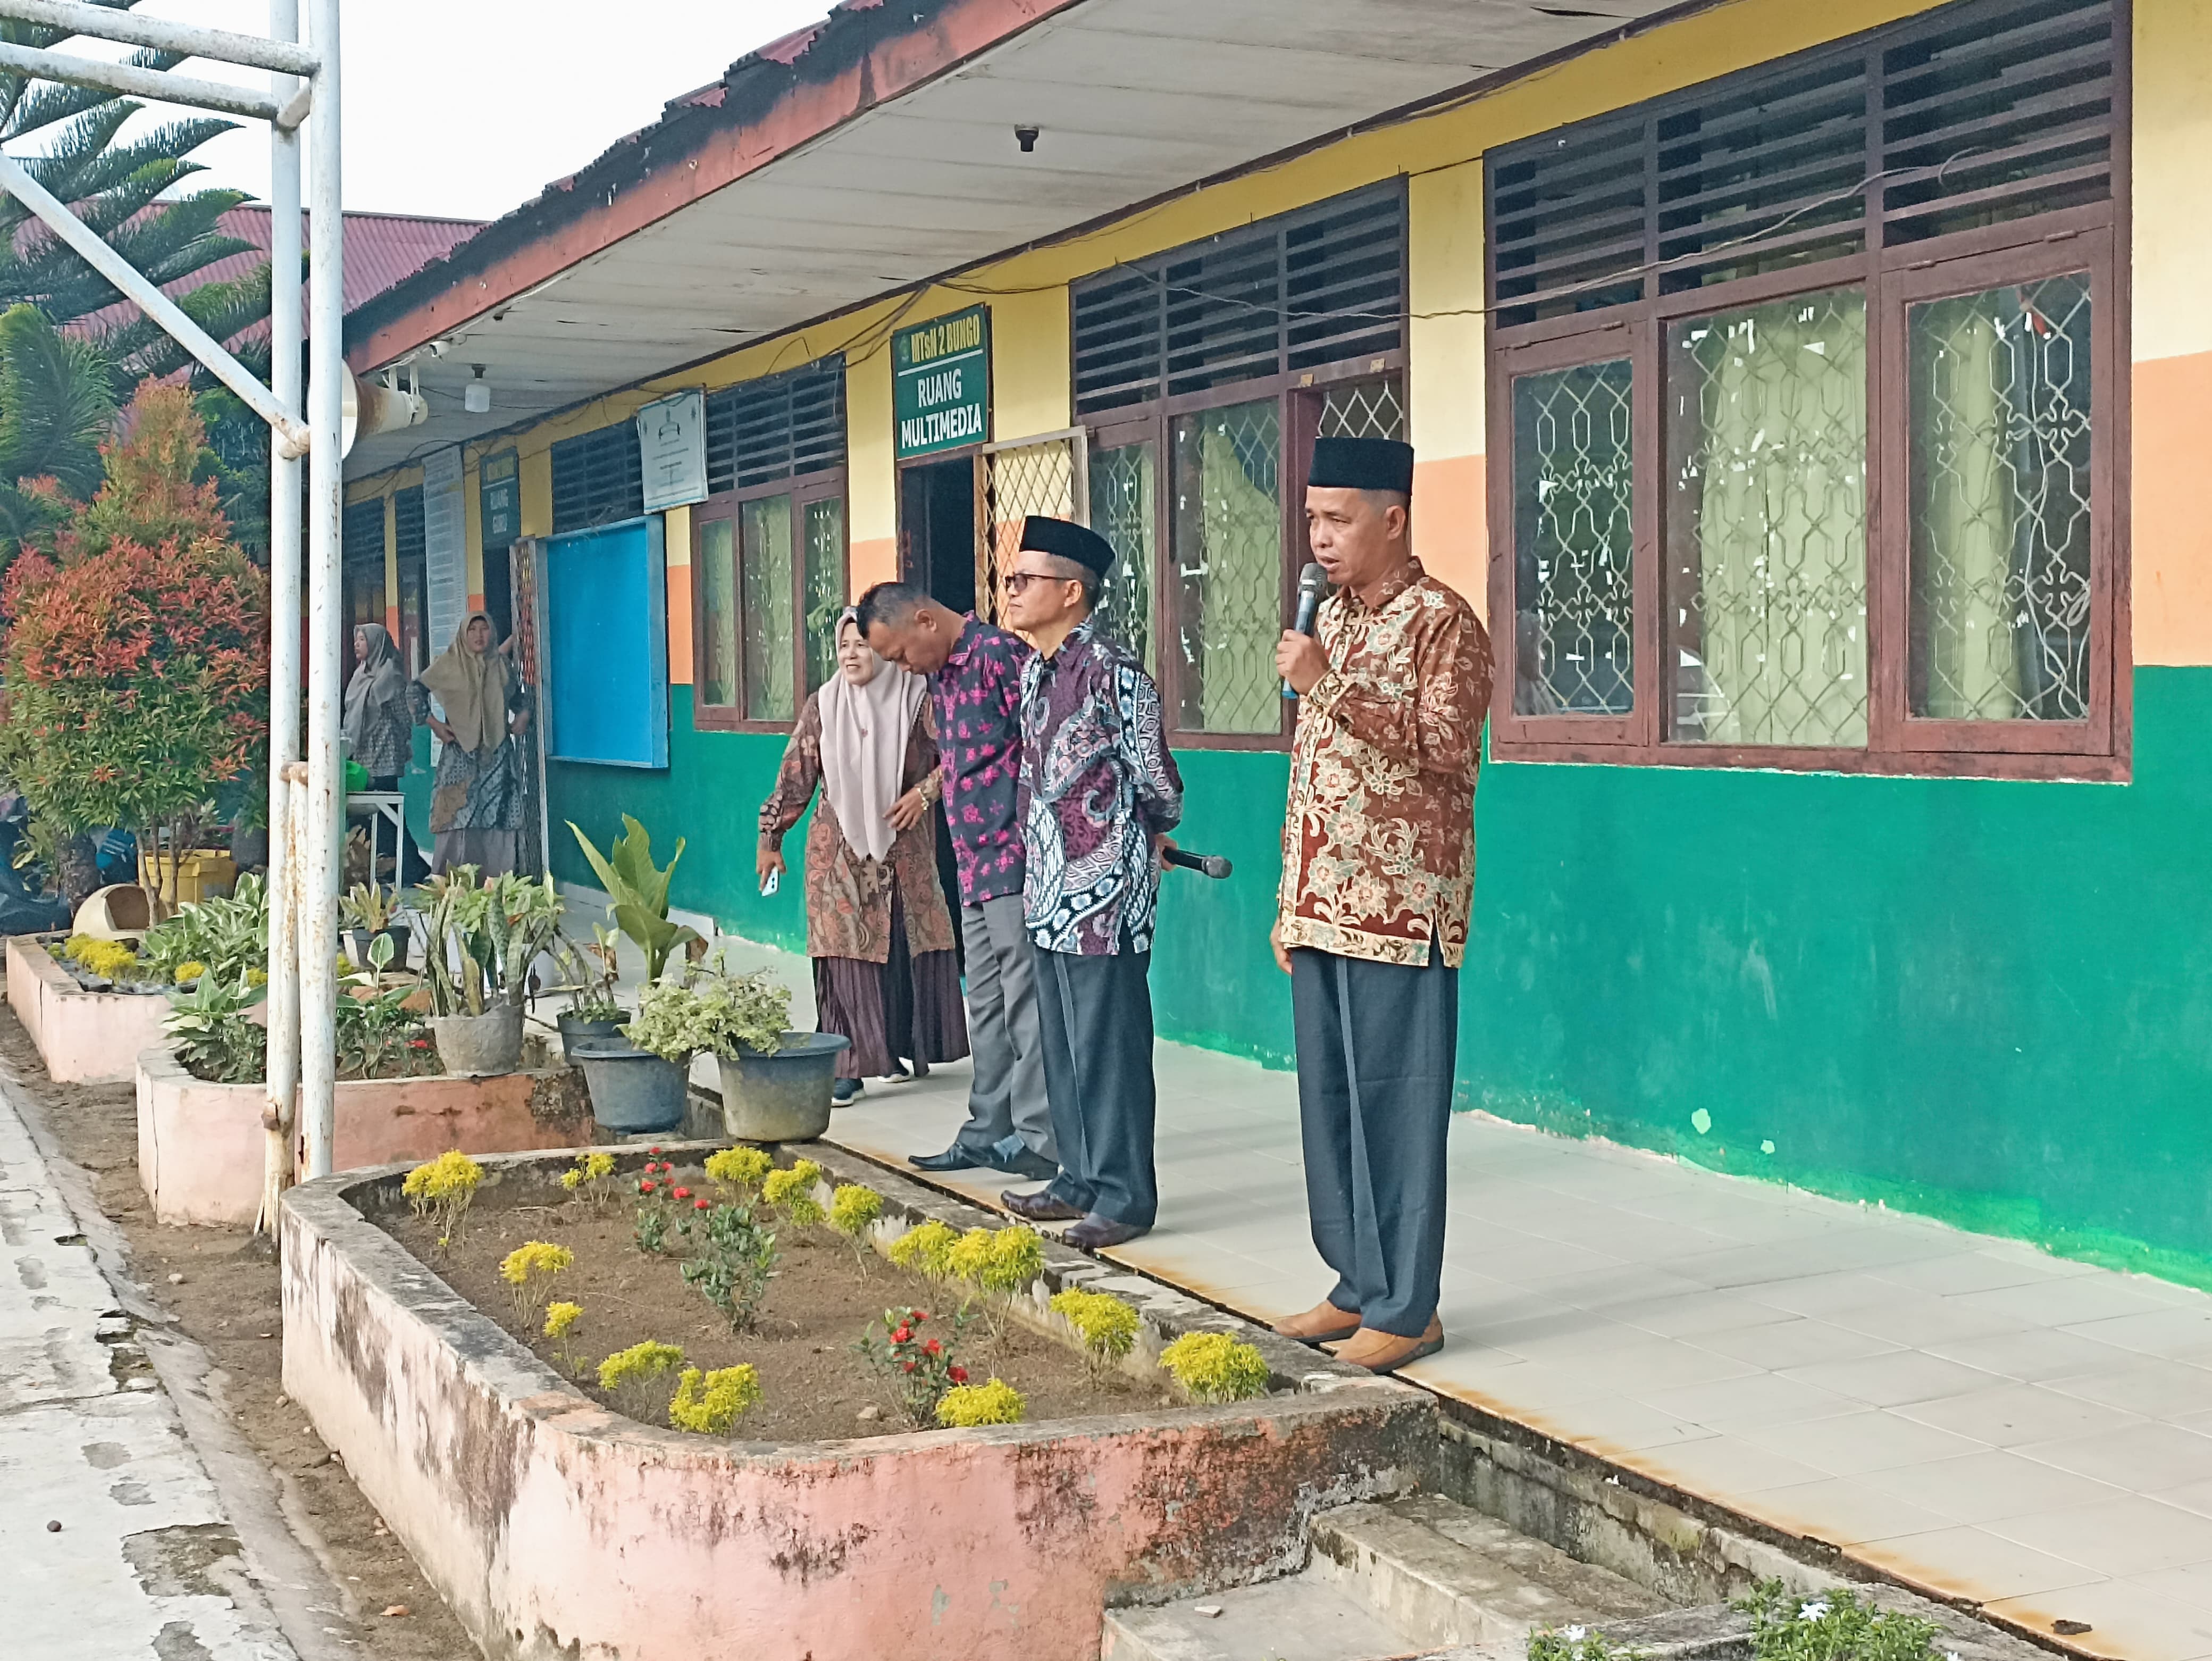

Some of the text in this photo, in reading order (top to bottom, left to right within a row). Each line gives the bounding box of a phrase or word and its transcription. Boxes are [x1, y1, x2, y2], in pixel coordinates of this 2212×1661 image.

[938, 325, 945, 355] 2
[946, 314, 980, 353] BUNGO
[918, 369, 962, 408] RUANG
[901, 403, 982, 449] MULTIMEDIA
